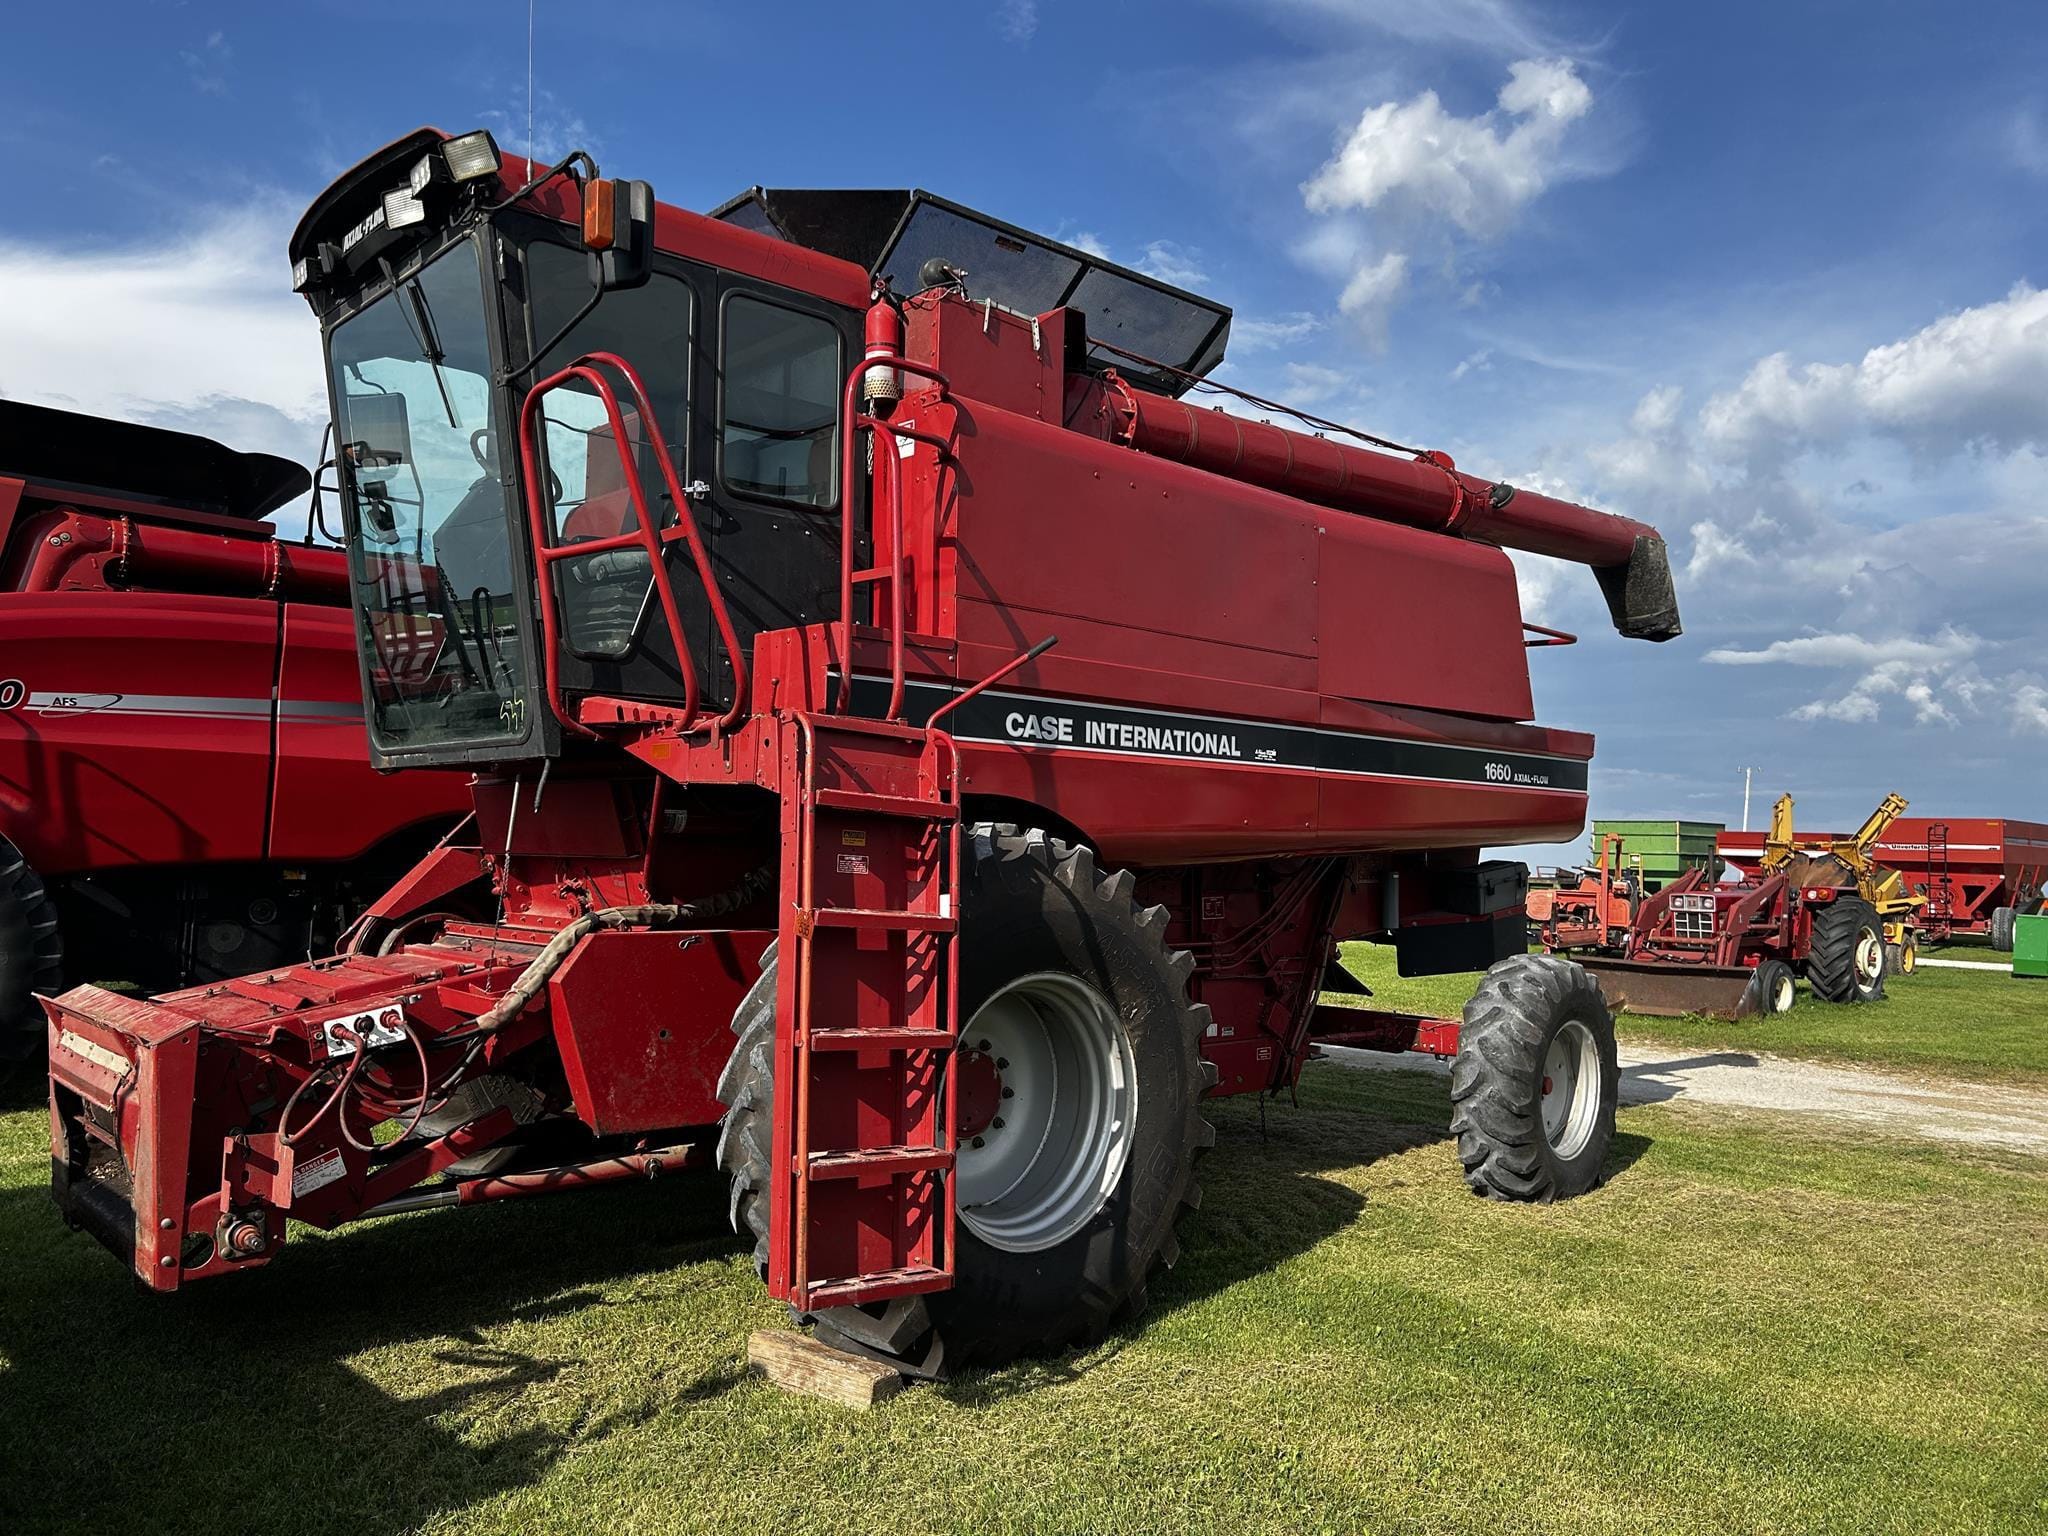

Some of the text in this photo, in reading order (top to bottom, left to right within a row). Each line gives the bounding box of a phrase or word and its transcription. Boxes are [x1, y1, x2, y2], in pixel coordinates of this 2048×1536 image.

[52, 696, 78, 706] AFS
[1005, 712, 1073, 742] CASE
[1085, 720, 1241, 757] INTERNATIONAL
[1484, 762, 1549, 785] 1660 AXIAL-FLOW
